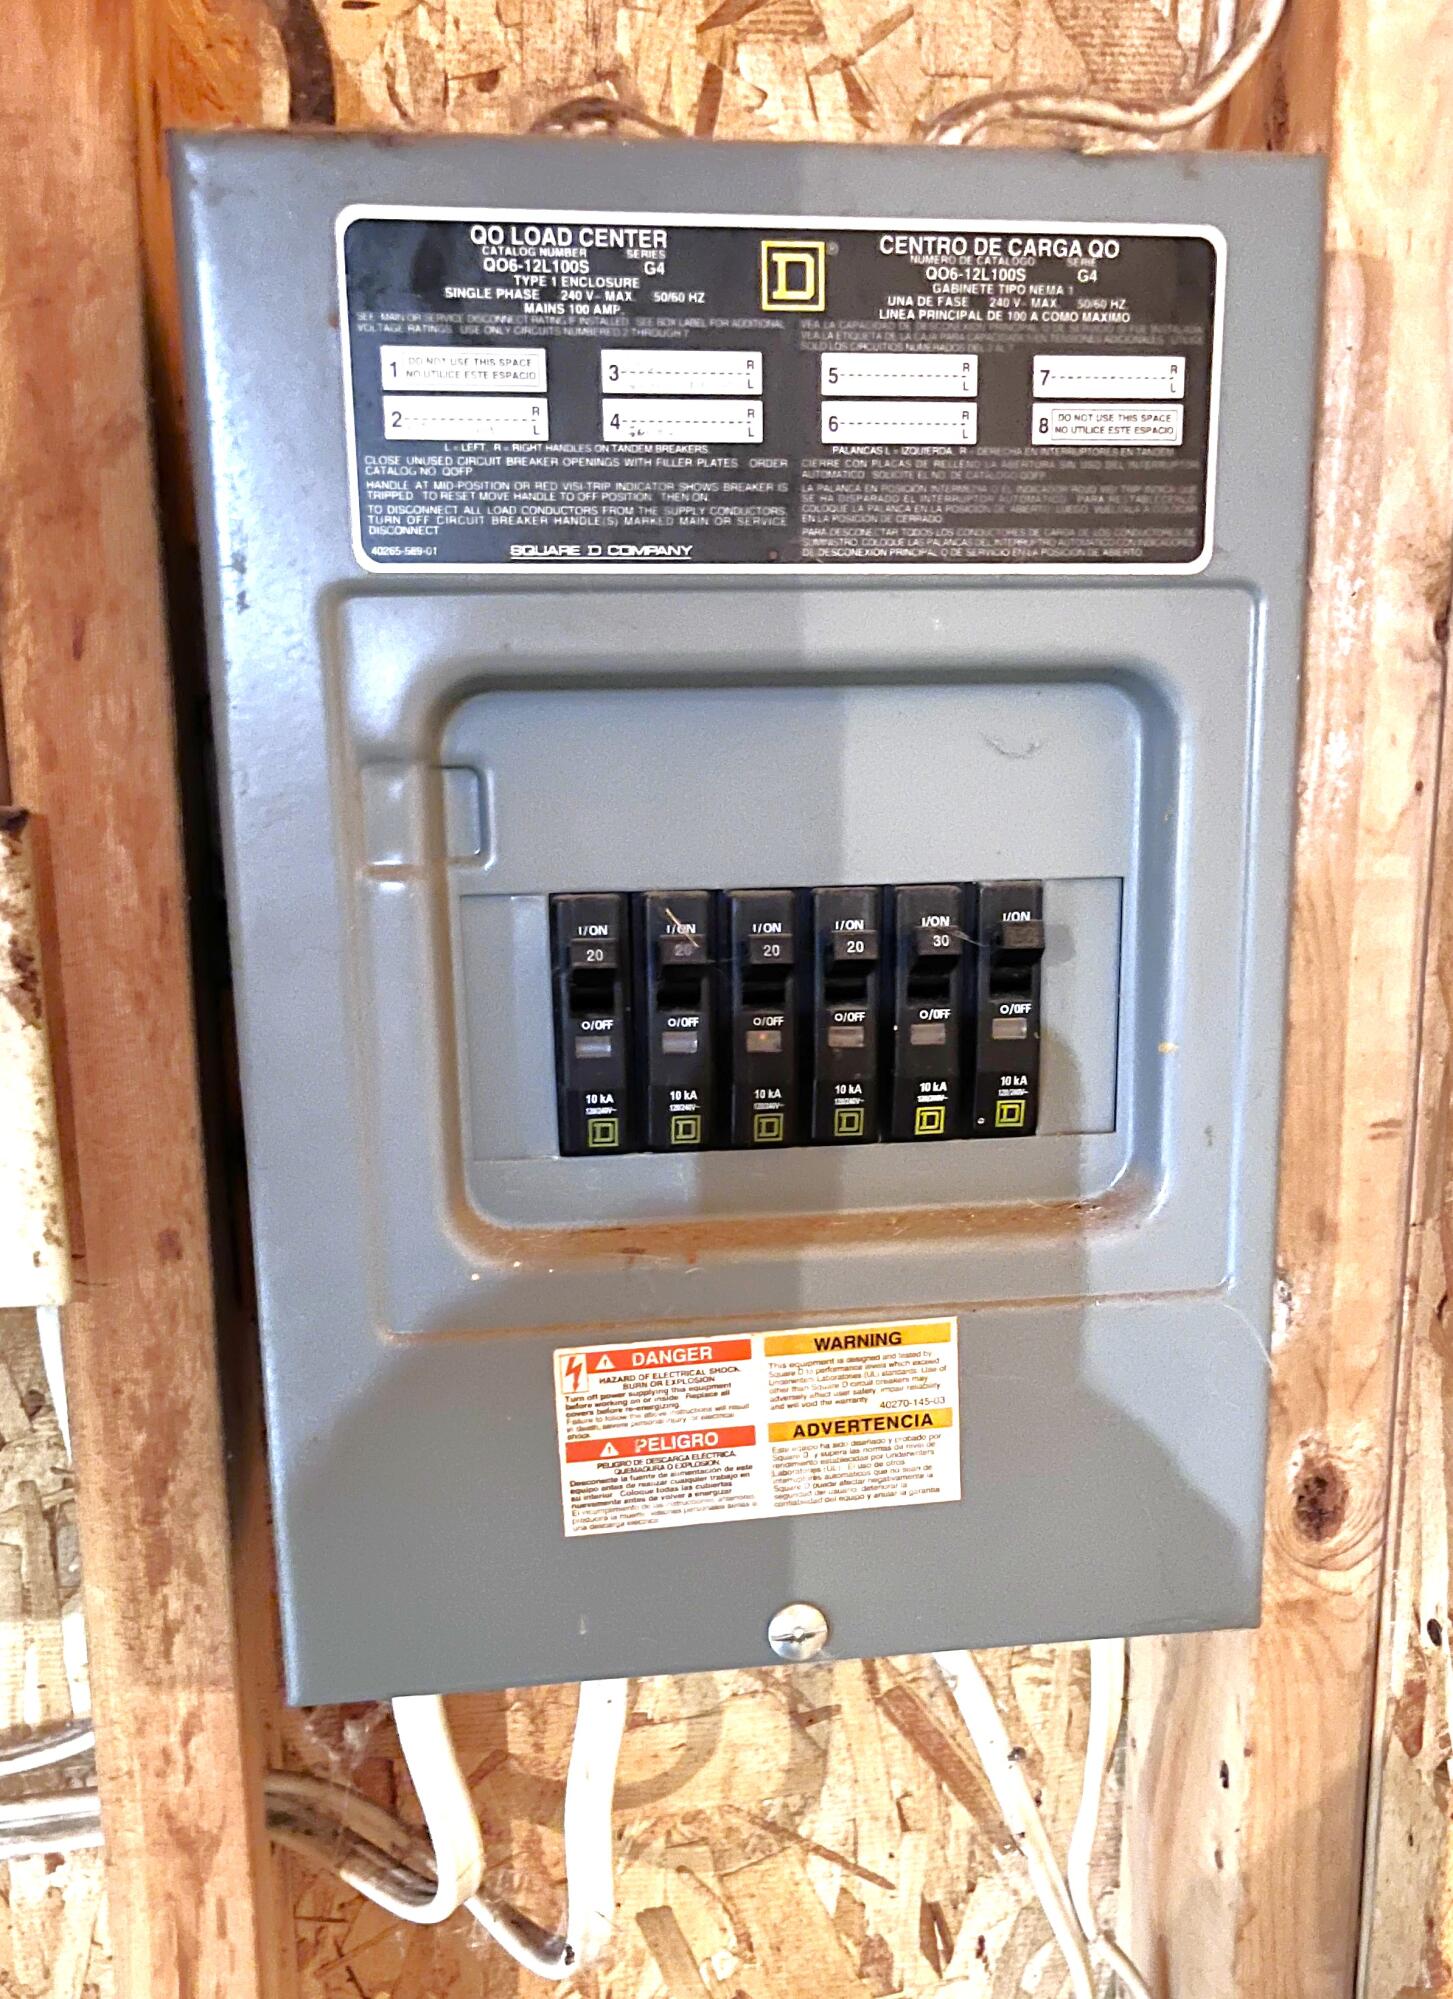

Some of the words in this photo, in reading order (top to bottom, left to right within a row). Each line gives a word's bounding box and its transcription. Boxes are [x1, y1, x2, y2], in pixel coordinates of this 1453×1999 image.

[470, 225, 504, 246] QO
[510, 226, 573, 247] LOAD
[579, 229, 667, 249] CENTER
[482, 246, 536, 257] CATALOG
[539, 247, 587, 258] NUMBER
[627, 249, 666, 260] SERIES
[879, 235, 968, 255] CENTRO
[973, 237, 1002, 256] DE
[1008, 238, 1083, 257] CARGA
[1088, 239, 1120, 259] QO
[483, 258, 590, 274] QO6-12L100S
[644, 261, 665, 276] G4
[925, 266, 1027, 281] QO6-12L100S
[1077, 268, 1098, 283] G4
[513, 275, 547, 288] TYPE
[551, 276, 556, 287] 1
[561, 276, 640, 289] ENCLOSURE
[445, 287, 492, 299] SINGLE
[496, 288, 540, 300] PHASE
[560, 289, 582, 301] 240
[653, 291, 685, 303] 50/60
[689, 292, 706, 303] HZ
[932, 284, 993, 295] GABINETE
[999, 284, 1026, 295] TIPO
[1029, 285, 1064, 296] NEMA
[888, 296, 914, 307] UNA
[917, 296, 935, 307] DE
[938, 297, 969, 308] FASE
[989, 297, 1009, 308] 240
[524, 302, 565, 315] MAINS
[569, 303, 591, 315] 100
[918, 310, 983, 321] PRINCIPAL
[987, 310, 1003, 321] DE
[1007, 311, 1027, 321] 100
[1030, 311, 1038, 321] A
[1041, 311, 1078, 322] COMO
[1082, 311, 1131, 323] MAXIMO
[390, 361, 397, 378] 1
[746, 360, 754, 370] R
[962, 361, 970, 372] R
[1170, 364, 1177, 374] R
[609, 364, 619, 381] 3
[828, 367, 838, 384] 5
[1039, 369, 1050, 386] 7
[747, 378, 754, 389] L
[962, 380, 969, 392] L
[1170, 382, 1176, 393] L
[532, 406, 540, 416] R
[747, 408, 755, 418] R
[962, 410, 969, 420] R
[391, 411, 402, 427] 2
[610, 413, 620, 430] 4
[828, 415, 838, 432] 6
[1058, 413, 1071, 422] DO
[1074, 413, 1093, 422] NOT
[1096, 414, 1114, 422] USE
[1118, 414, 1137, 422] THIS
[1141, 414, 1172, 423] SPACE
[533, 425, 540, 435] L
[1038, 417, 1049, 434] 8
[1055, 426, 1068, 434] NO
[1108, 426, 1130, 435] ESTE
[1134, 426, 1173, 435] ESPACIO
[748, 427, 755, 437] L
[962, 428, 969, 439] L
[444, 443, 449, 452] L
[493, 443, 501, 452] R
[512, 443, 542, 452] RIGHT
[545, 444, 592, 453] HANDLES
[594, 444, 610, 453] ON
[611, 444, 653, 453] TANDEM
[364, 455, 400, 466] CLOSE
[406, 455, 453, 466] UNUSED
[457, 456, 501, 466] CIRCUIT
[506, 457, 558, 467] BREAKER
[562, 457, 620, 467] OPENINGS
[624, 458, 652, 467] WITH
[656, 458, 692, 467] FILLER
[749, 459, 789, 468] ORDER
[365, 466, 417, 476] CATALOG
[510, 544, 580, 556] SQUARE
[587, 545, 601, 556] D
[607, 545, 694, 556] COMPANY
[847, 941, 864, 953] 20
[933, 935, 950, 947] 30
[586, 949, 604, 962] 20
[763, 944, 780, 957] 20
[919, 1008, 952, 1020] O/OFF
[999, 1003, 1032, 1014] O/OFF
[667, 1017, 699, 1028] O/OFF
[752, 1015, 784, 1026] O/OFF
[834, 1011, 865, 1022] O/OFF
[581, 1020, 614, 1031] O/OFF
[920, 1082, 931, 1093] 10
[933, 1081, 948, 1092] kA
[1000, 1076, 1011, 1087] 10
[1013, 1075, 1028, 1086] kA
[670, 1090, 681, 1101] 10
[684, 1090, 698, 1101] kA
[754, 1089, 766, 1099] 10
[767, 1088, 782, 1099] kA
[835, 1084, 846, 1095] 10
[848, 1084, 862, 1095] kA
[586, 1094, 598, 1104] 10
[599, 1093, 614, 1104] kA
[814, 1331, 902, 1352] WARNING
[631, 1346, 713, 1367] DANGER
[599, 1374, 636, 1385] HAZARD
[638, 1373, 650, 1382] OF
[652, 1369, 707, 1380] ELECTRICAL
[622, 1382, 648, 1391] BURN
[650, 1380, 663, 1389] OR
[665, 1376, 715, 1388] EXPLOSION
[793, 1412, 933, 1439] ADVERTENCIA
[635, 1432, 719, 1454] PELIGRO
